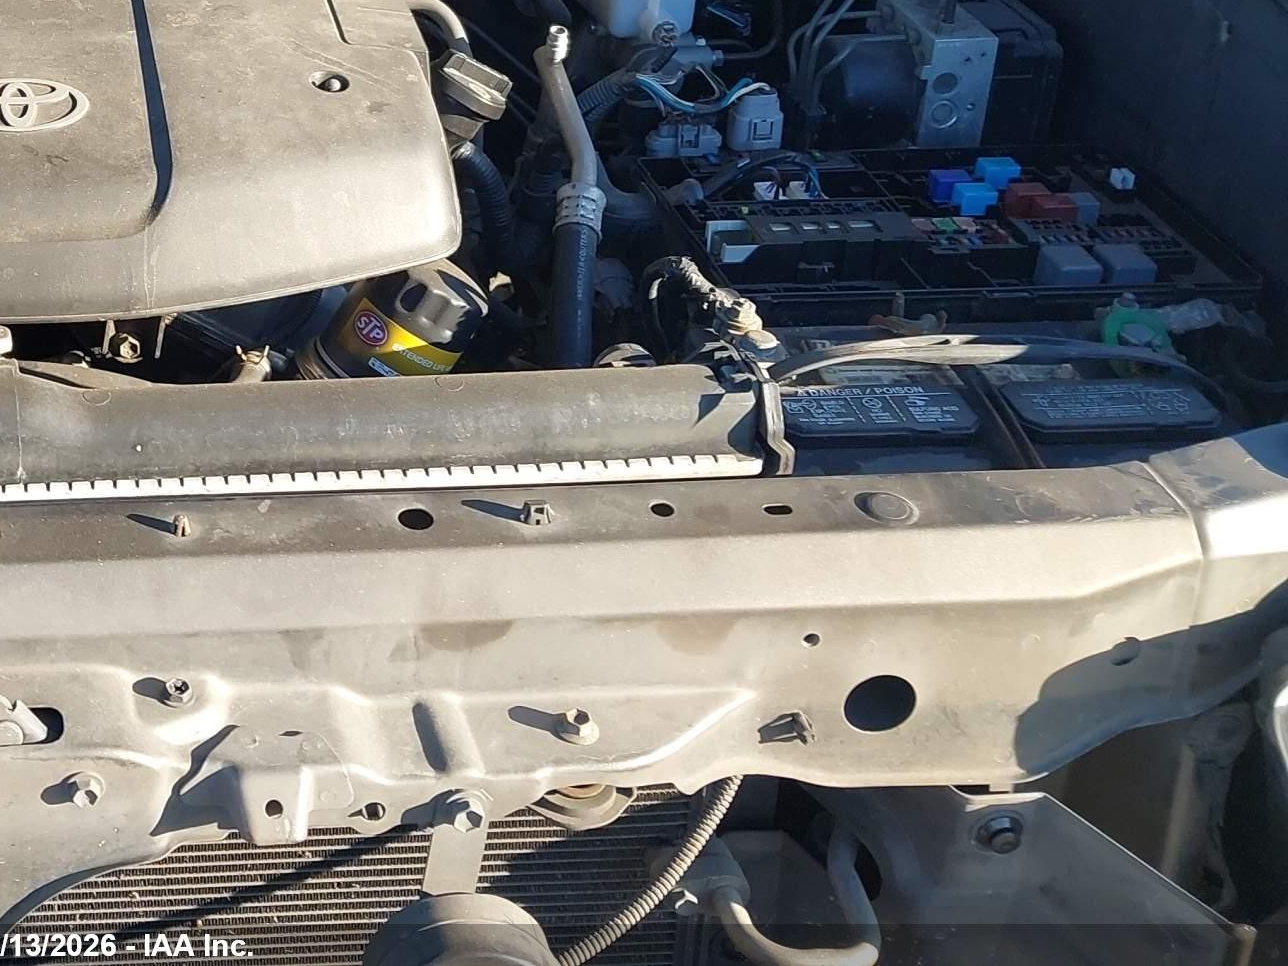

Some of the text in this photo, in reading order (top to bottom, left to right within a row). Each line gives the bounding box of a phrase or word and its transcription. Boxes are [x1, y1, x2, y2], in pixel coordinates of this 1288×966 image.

[356, 315, 385, 341] STP
[392, 343, 433, 368] EXTENDED
[810, 388, 862, 397] DANGER
[874, 386, 924, 395] POISON
